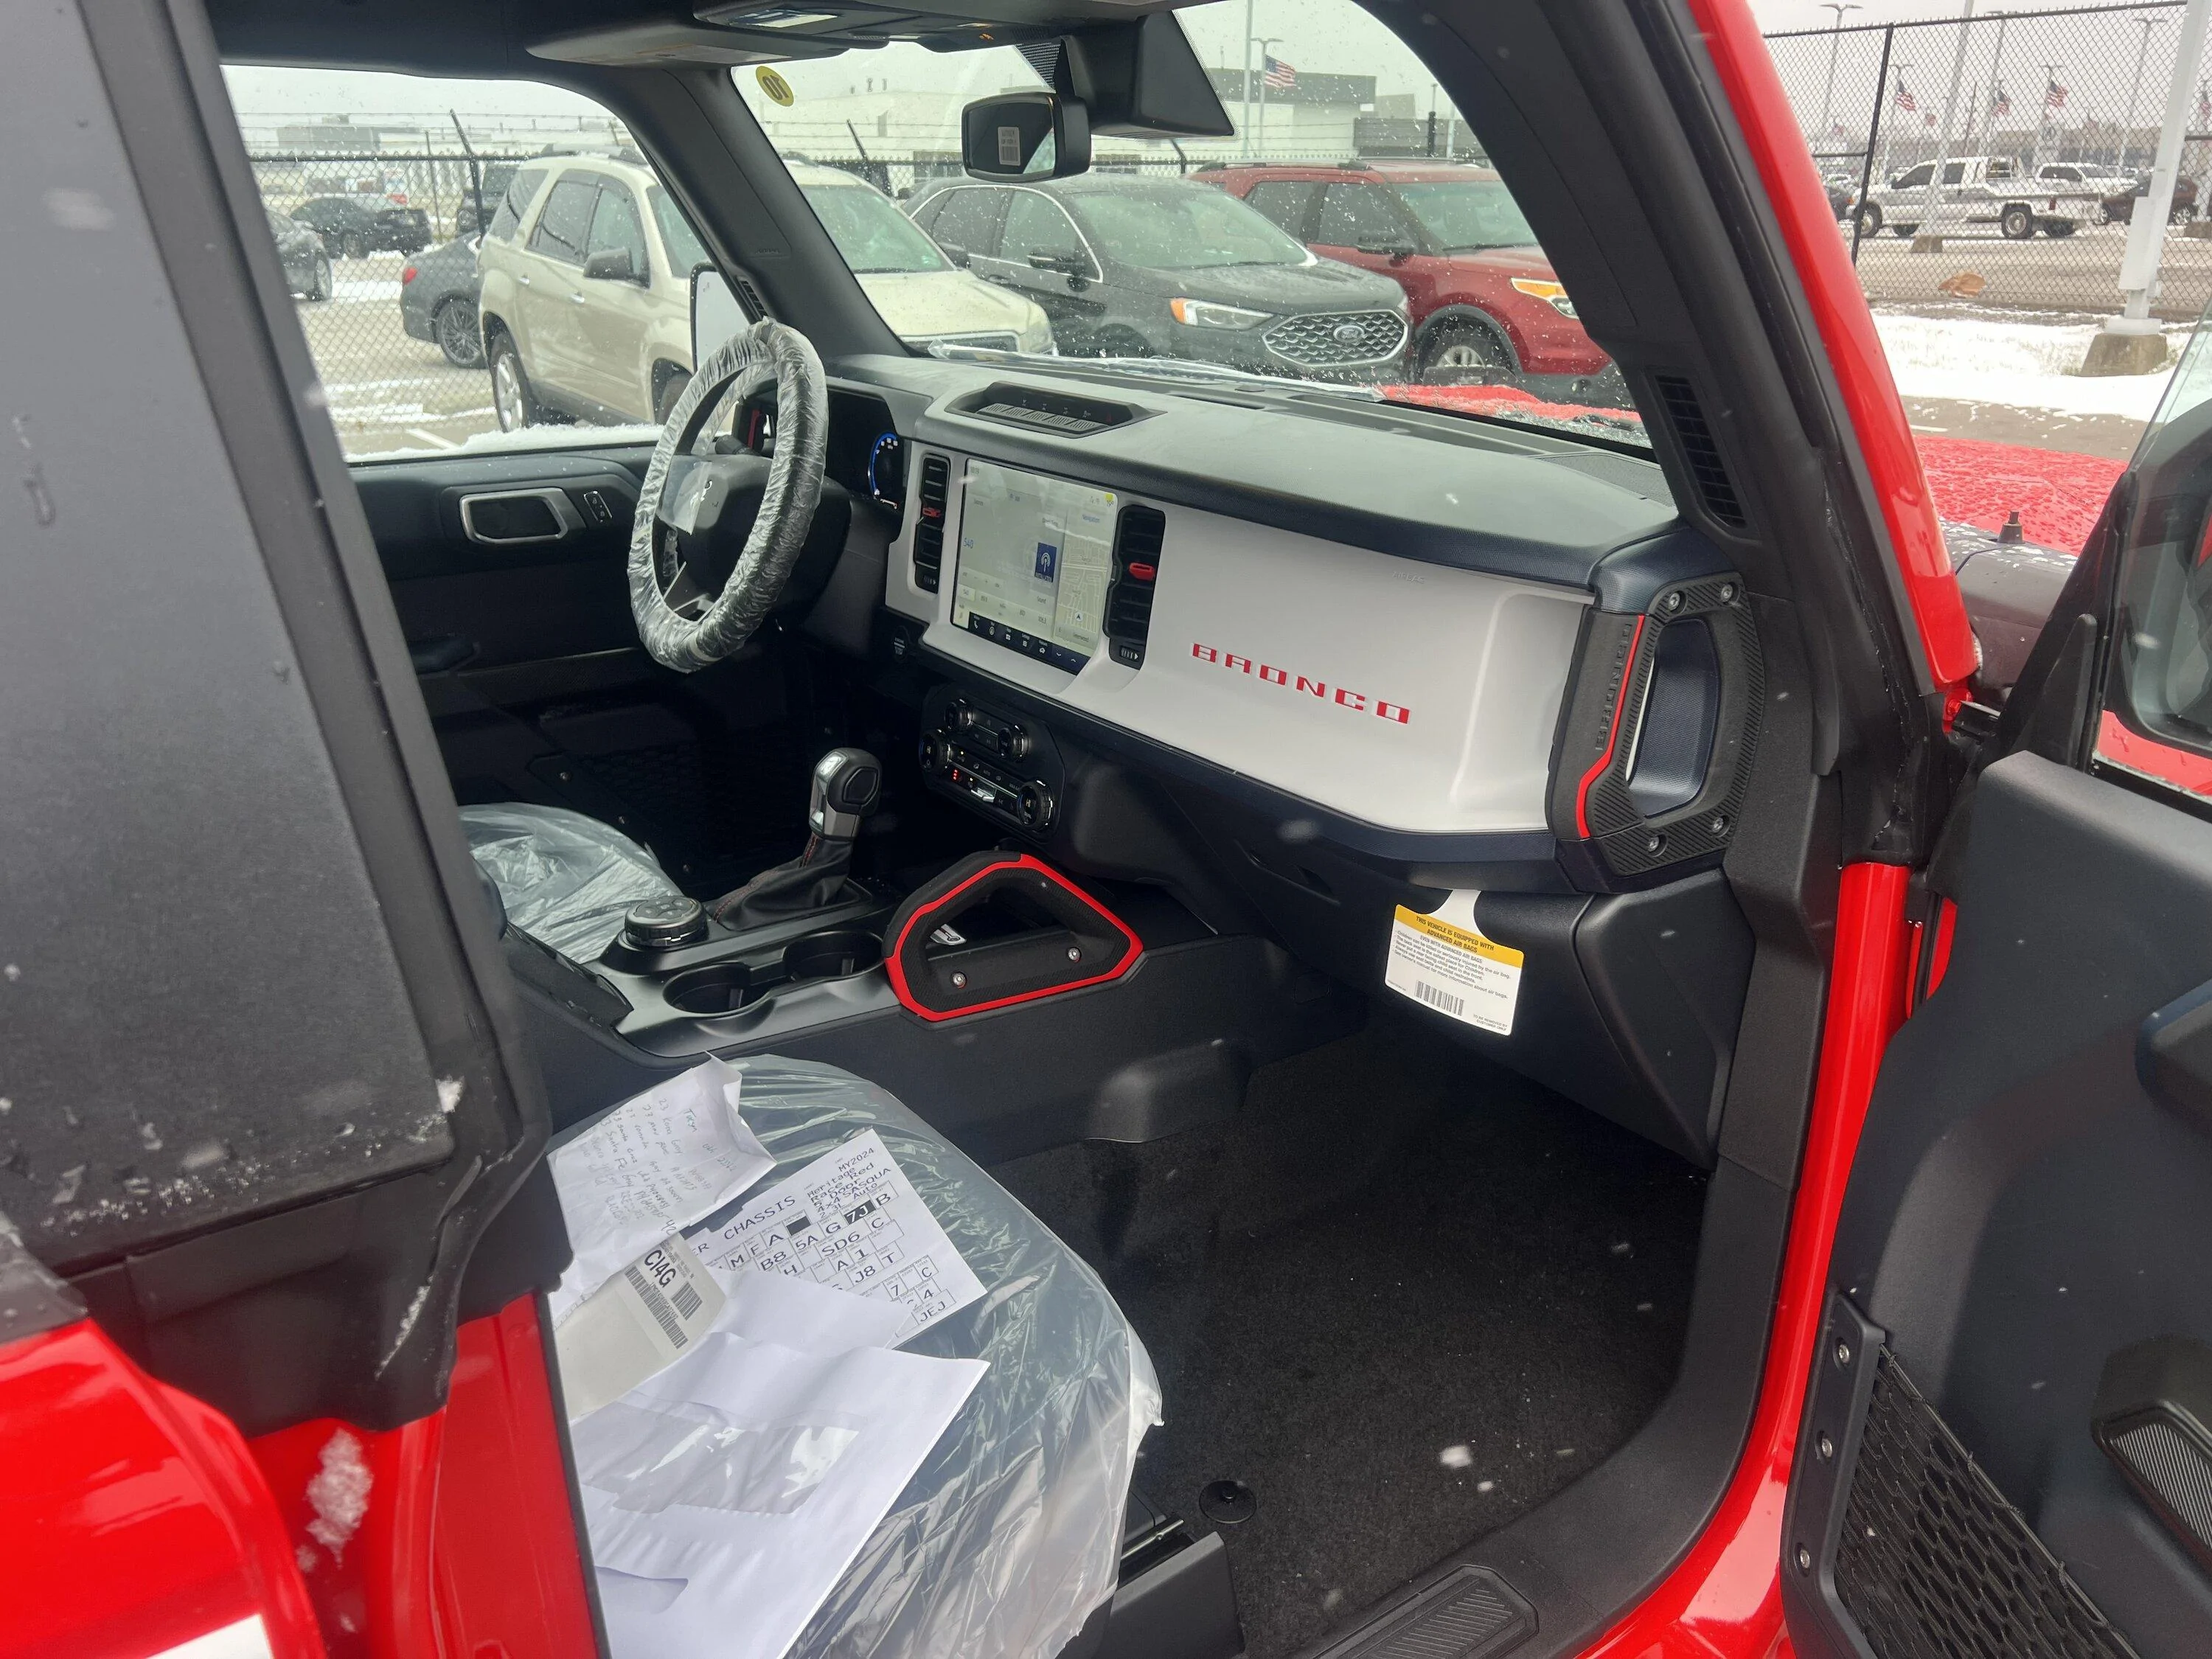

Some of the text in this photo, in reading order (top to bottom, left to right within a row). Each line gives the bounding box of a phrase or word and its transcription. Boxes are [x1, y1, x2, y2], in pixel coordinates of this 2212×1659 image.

[1191, 643, 1410, 724] BRONCO
[1416, 916, 1427, 925] THIS
[1427, 921, 1447, 933] VEHICLE
[1453, 932, 1479, 946] EQUIPPED
[1479, 942, 1495, 951] WITH
[1427, 928, 1478, 953] ADVANCED AIR BAGS
[838, 1148, 874, 1172] MY2024
[807, 1168, 855, 1198] Heritage
[811, 1163, 874, 1203] Race Red
[830, 1178, 861, 1199] Door
[842, 1168, 891, 1197] SASQUA
[853, 1183, 878, 1200] Auto
[724, 1195, 796, 1240] CHASSIS
[760, 1193, 891, 1271] B8 5A G 7J B
[730, 1254, 745, 1267] M
[769, 1234, 784, 1246] A
[821, 1231, 860, 1256] SD6
[872, 1217, 884, 1229] C
[837, 1260, 849, 1272] A
[855, 1252, 895, 1284] J8 T
[891, 1267, 933, 1296] 7 C
[924, 1289, 934, 1299] 4
[920, 1301, 946, 1322] JEJ
